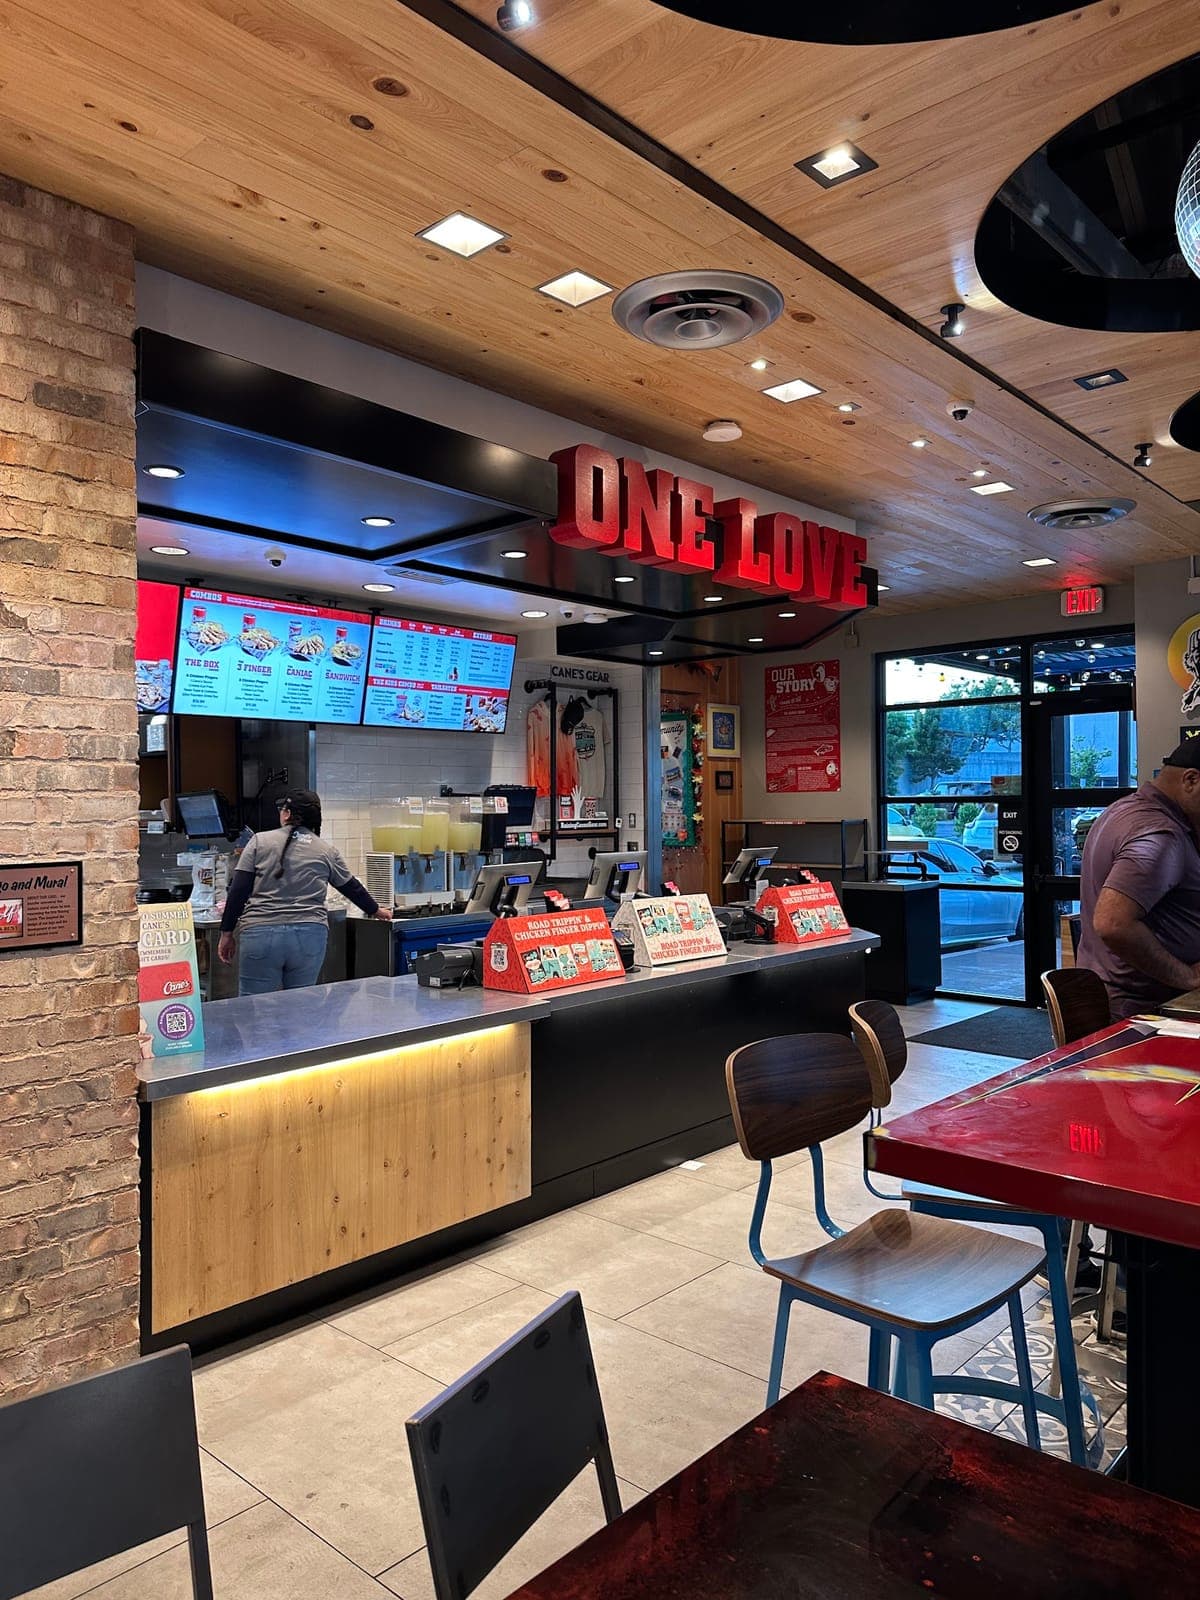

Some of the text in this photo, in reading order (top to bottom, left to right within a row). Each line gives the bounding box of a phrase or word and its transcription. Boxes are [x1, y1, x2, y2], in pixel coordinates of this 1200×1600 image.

[550, 443, 867, 609] ONE LOVE
[190, 589, 222, 601] COMBOS
[1067, 588, 1097, 613] EXIT
[185, 658, 220, 669] THE BOX
[244, 664, 272, 674] FINGER
[286, 668, 313, 678] CANIAC
[325, 672, 361, 682] SANDWICH
[551, 666, 609, 682] CANE'S GEAR
[771, 668, 795, 681] OUR
[776, 678, 817, 693] STORY
[1003, 811, 1018, 819] EXIT
[11, 878, 33, 891] and
[34, 875, 69, 890] Mural
[150, 910, 189, 920] SUMMER
[142, 921, 170, 930] CANE'S
[527, 914, 592, 931] ROAD TRIPPIN' &
[141, 929, 191, 947] CARD
[514, 921, 606, 941] CHICKEN FINGER DIPPIN'
[660, 940, 679, 951] ROAD
[705, 936, 712, 944] &
[650, 949, 680, 960] CHICKEN
[679, 946, 702, 956] FINGER
[163, 979, 190, 995] Cane's
